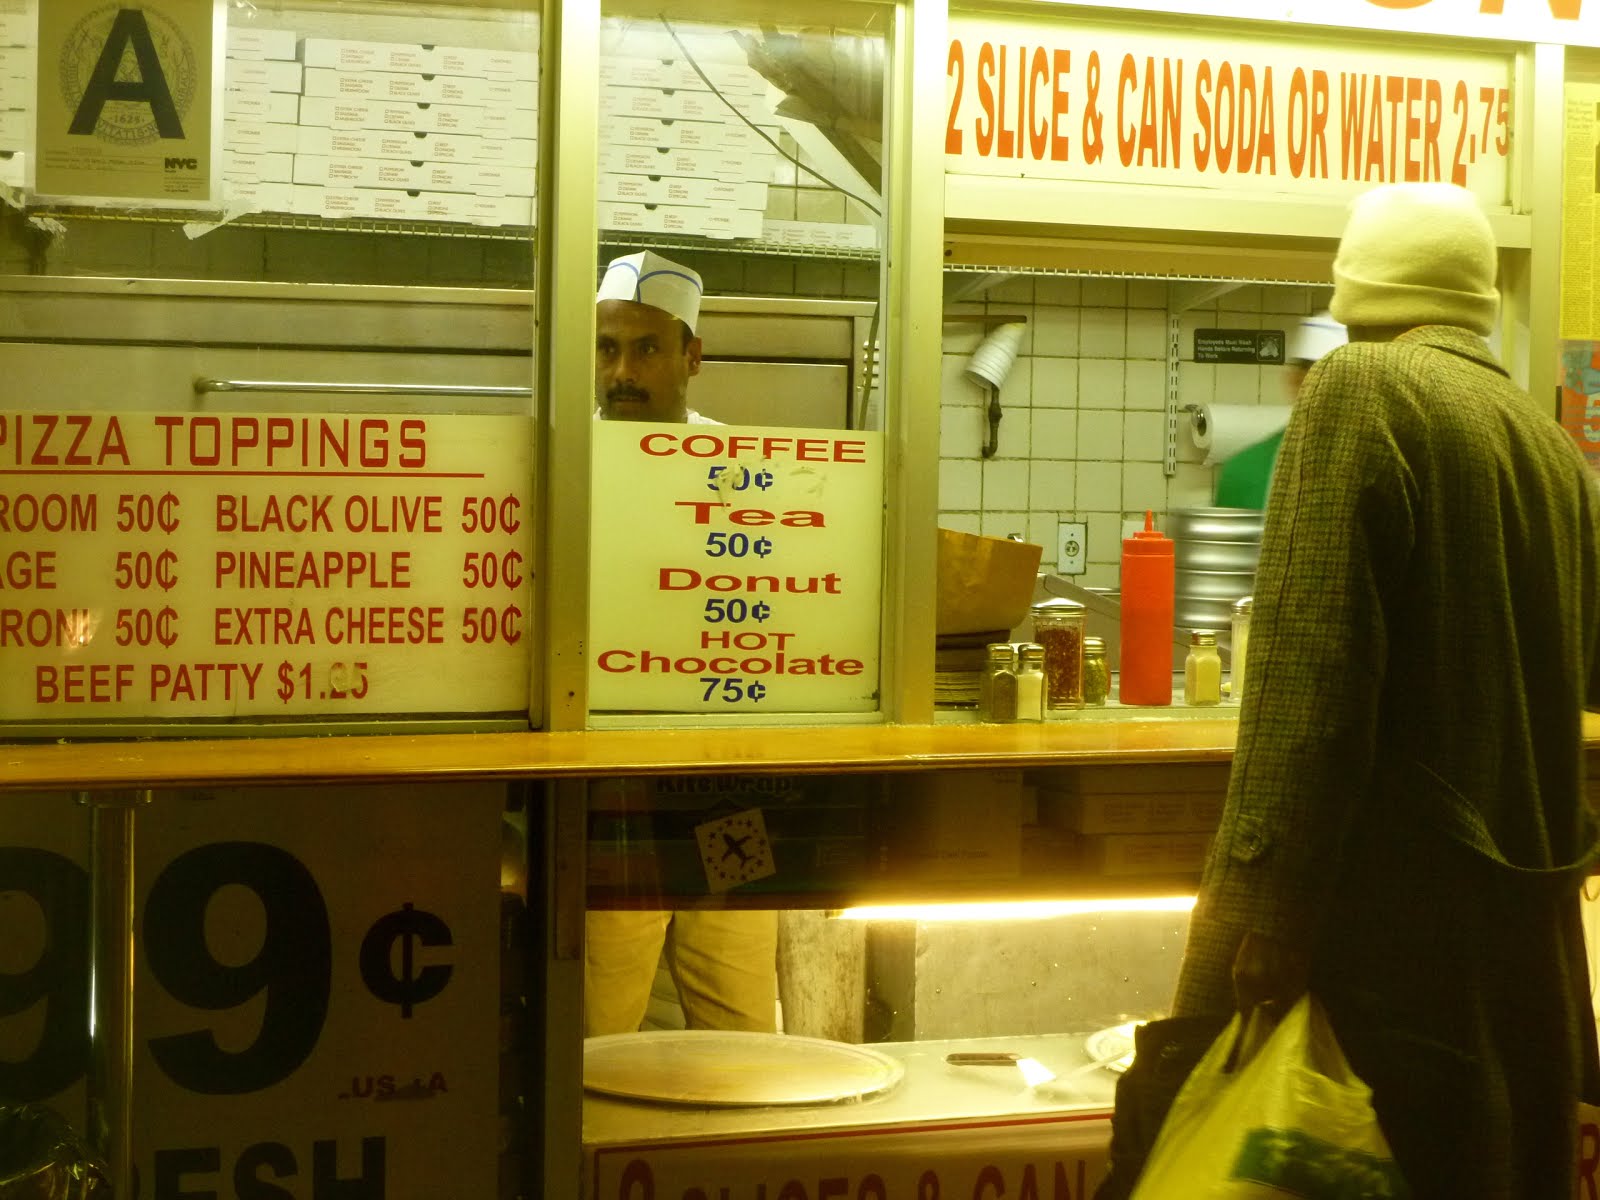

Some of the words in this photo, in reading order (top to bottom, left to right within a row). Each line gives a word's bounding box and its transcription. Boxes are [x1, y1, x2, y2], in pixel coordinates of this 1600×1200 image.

[67, 9, 186, 140] A
[944, 39, 965, 155] 2
[975, 41, 1071, 162] SLICE
[1082, 50, 1104, 165] &
[1117, 53, 1183, 169] CAN
[1193, 59, 1277, 176] SODA
[1287, 66, 1330, 179] OR
[1340, 72, 1442, 183] WATER
[164, 157, 197, 170] NYC
[0, 415, 131, 466] IZZA
[154, 416, 426, 468] TOPPINGS
[639, 433, 866, 463] COFFEE
[117, 491, 180, 535] 50¢
[216, 494, 333, 532] BLACK
[344, 495, 442, 533] OLIVE
[461, 493, 521, 535] 50¢
[675, 501, 826, 527] Tea
[705, 532, 772, 558] 50¢
[0, 551, 56, 589] GE
[115, 549, 179, 592] 50¢
[216, 551, 411, 589] PINEAPPLE
[462, 549, 523, 591] 50¢
[659, 568, 842, 594] Donut
[115, 605, 179, 649] 50¢
[214, 607, 316, 645] EXTRA
[325, 606, 444, 644] CHEESE
[461, 604, 523, 646] 50¢
[703, 599, 771, 623] 50¢
[700, 631, 796, 651] HOT
[36, 665, 134, 703] BEEF
[151, 663, 263, 702] PATTY
[597, 650, 865, 676] Chocolate
[699, 678, 766, 703] 75¢
[132, 1136, 386, 1200] ESH
